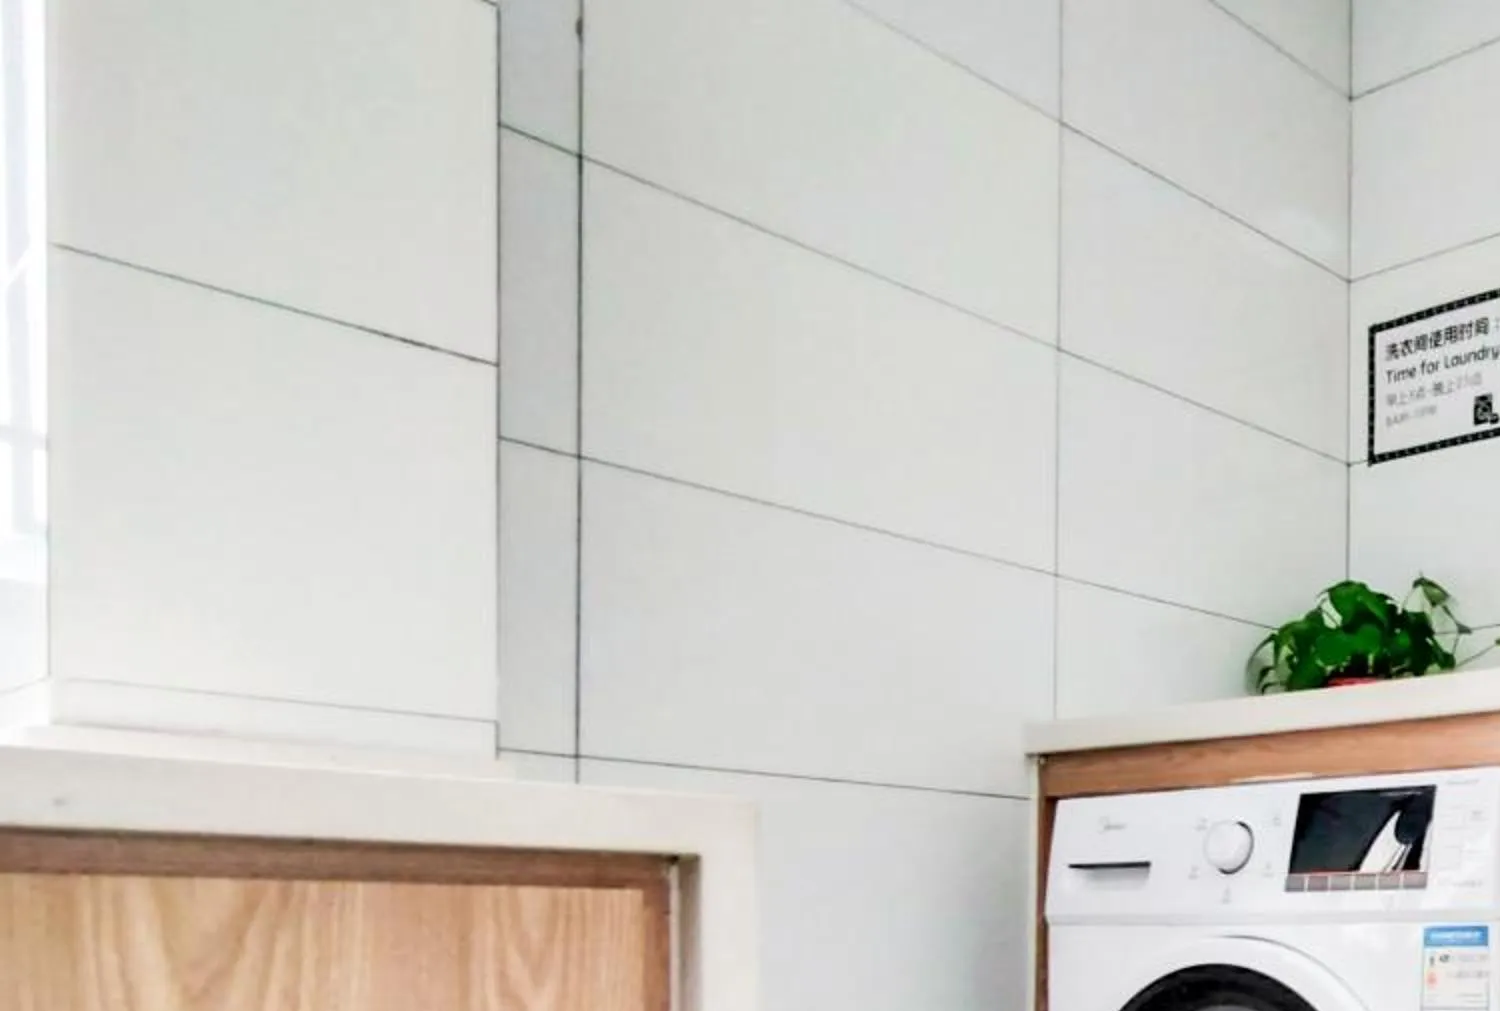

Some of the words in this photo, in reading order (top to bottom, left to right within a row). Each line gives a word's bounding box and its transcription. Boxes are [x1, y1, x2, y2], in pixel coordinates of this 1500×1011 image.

[1386, 366, 1417, 385] Time
[1420, 359, 1440, 376] for
[1444, 346, 1500, 369] Laundry
